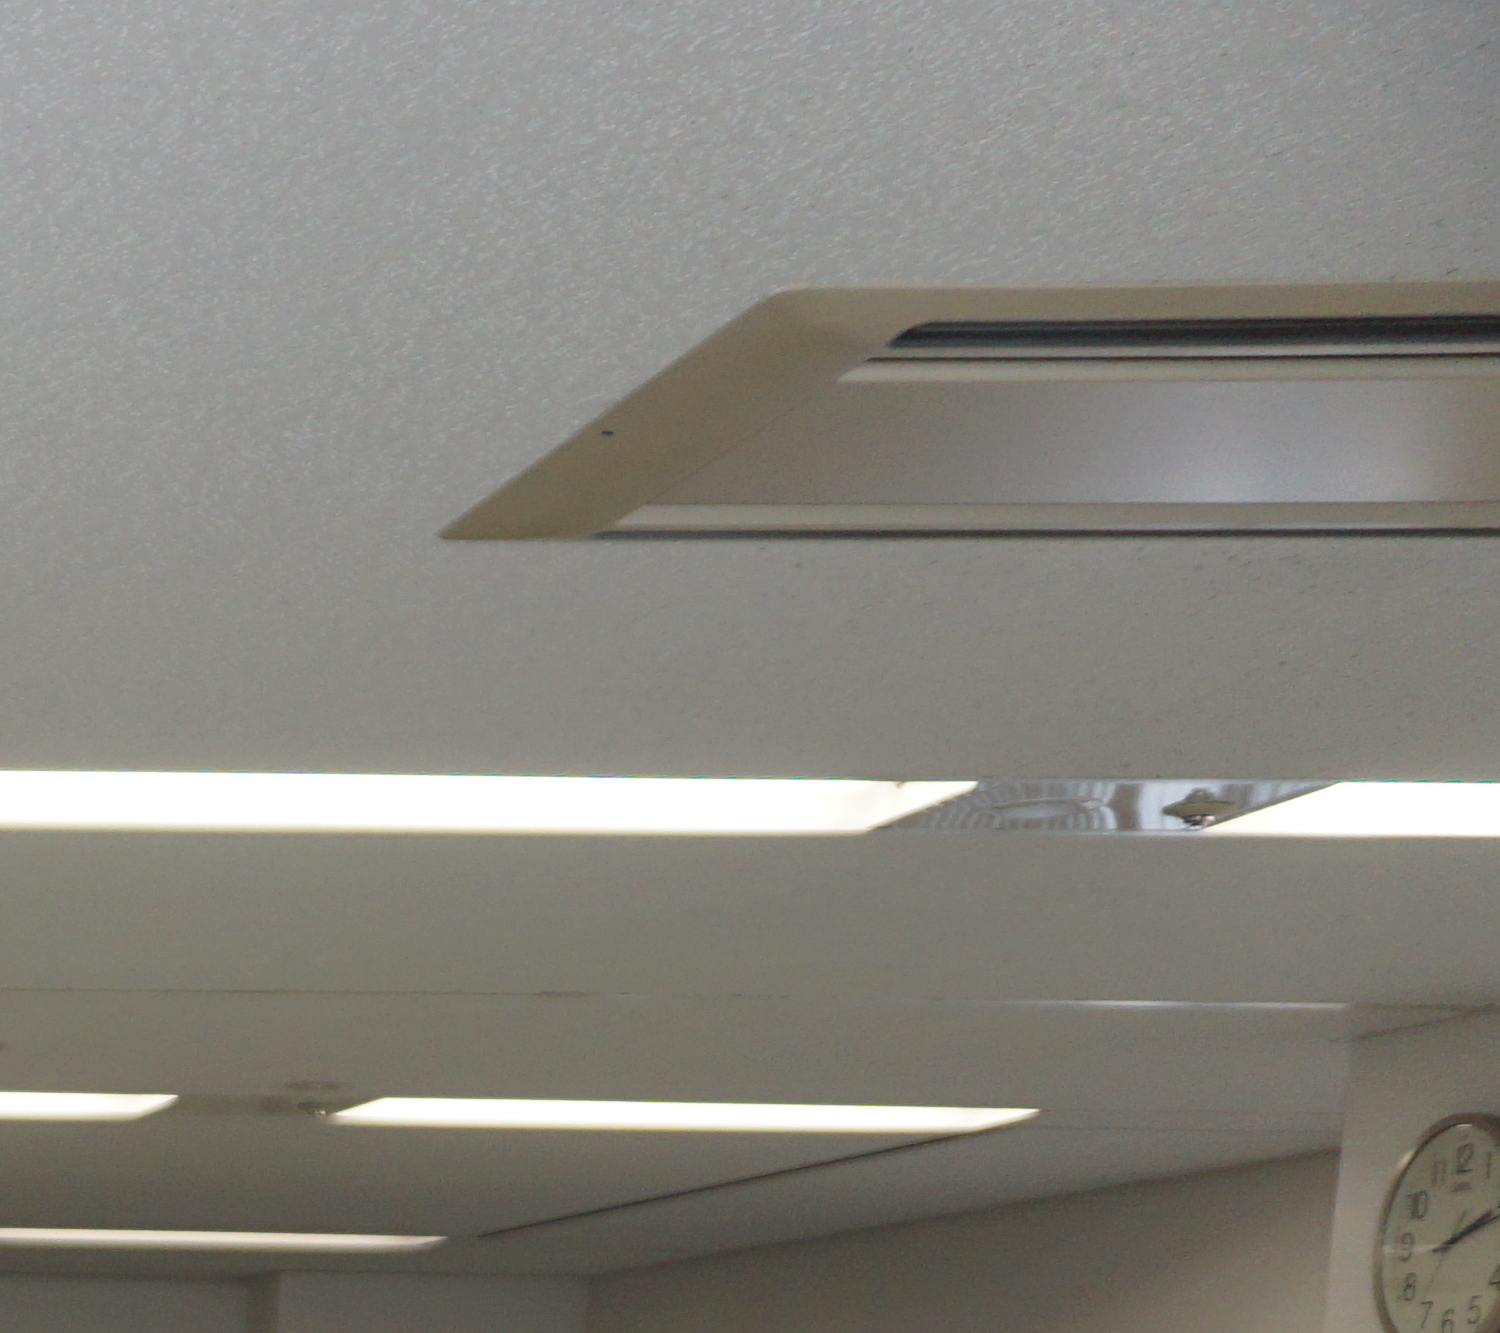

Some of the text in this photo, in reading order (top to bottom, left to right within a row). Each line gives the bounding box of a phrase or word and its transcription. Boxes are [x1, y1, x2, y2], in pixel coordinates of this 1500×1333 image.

[1403, 1272, 1417, 1302] 8
[1420, 1300, 1433, 1330] 7
[1467, 1294, 1481, 1326] 5
